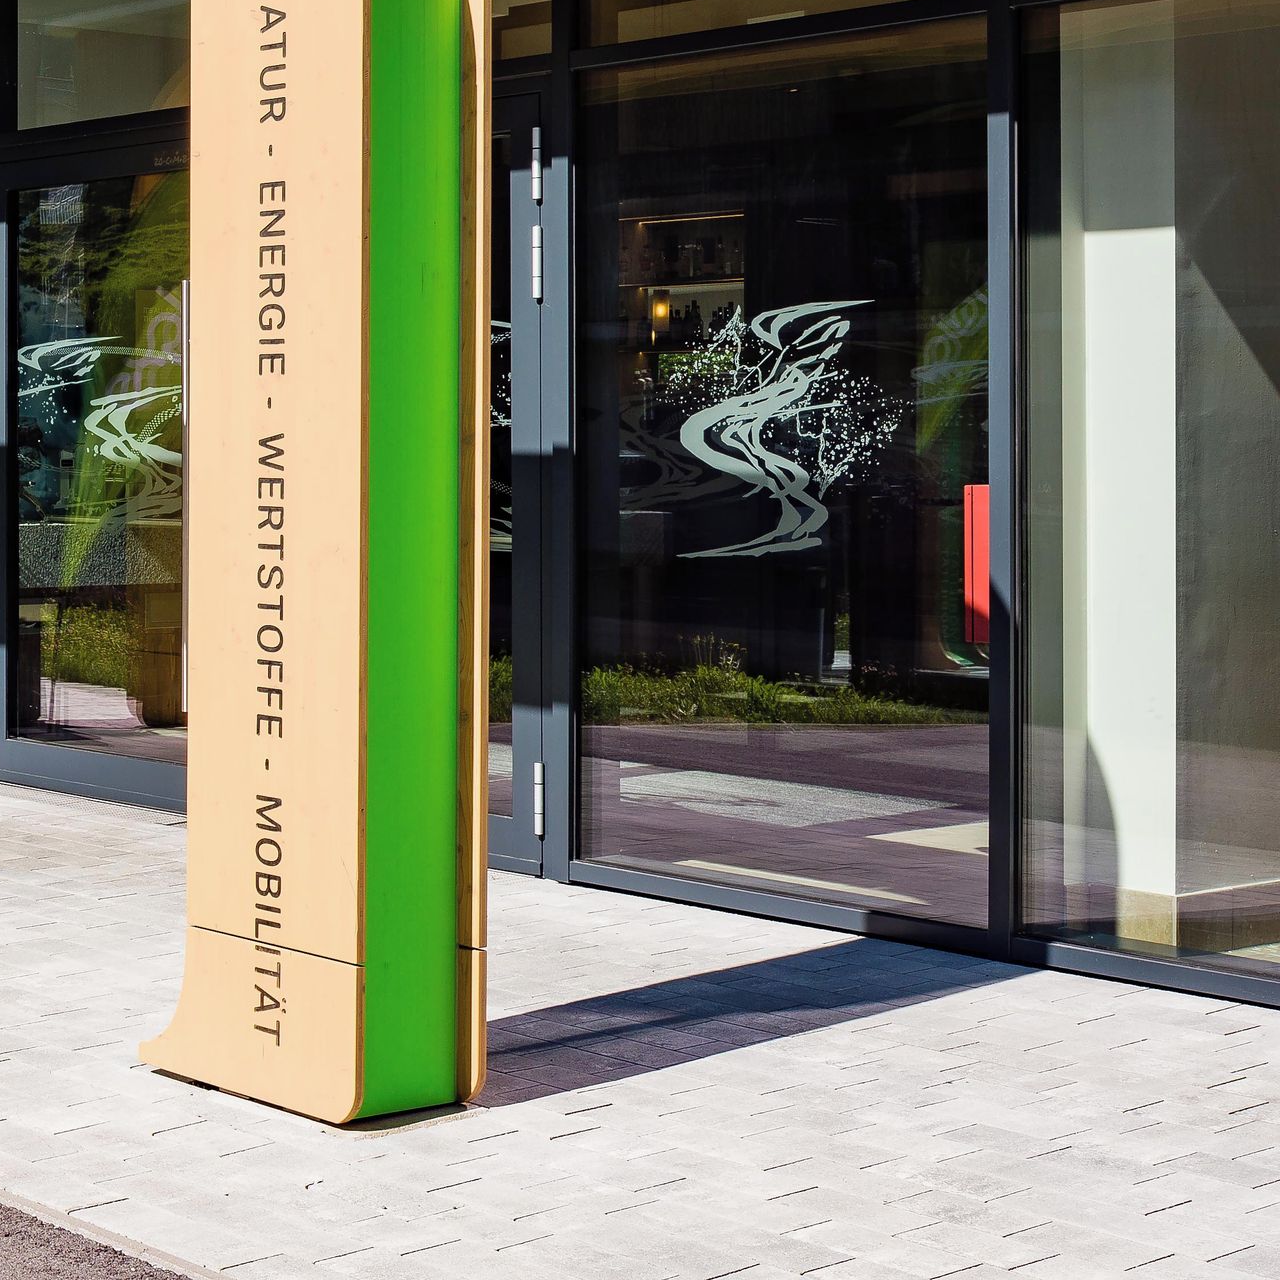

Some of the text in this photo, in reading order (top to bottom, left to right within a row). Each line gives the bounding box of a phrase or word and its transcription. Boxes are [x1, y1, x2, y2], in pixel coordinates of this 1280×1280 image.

[258, 180, 286, 376] ENERGIE
[256, 432, 285, 739] WERTSTOFFE
[253, 794, 288, 1047] MOBILITÄT
